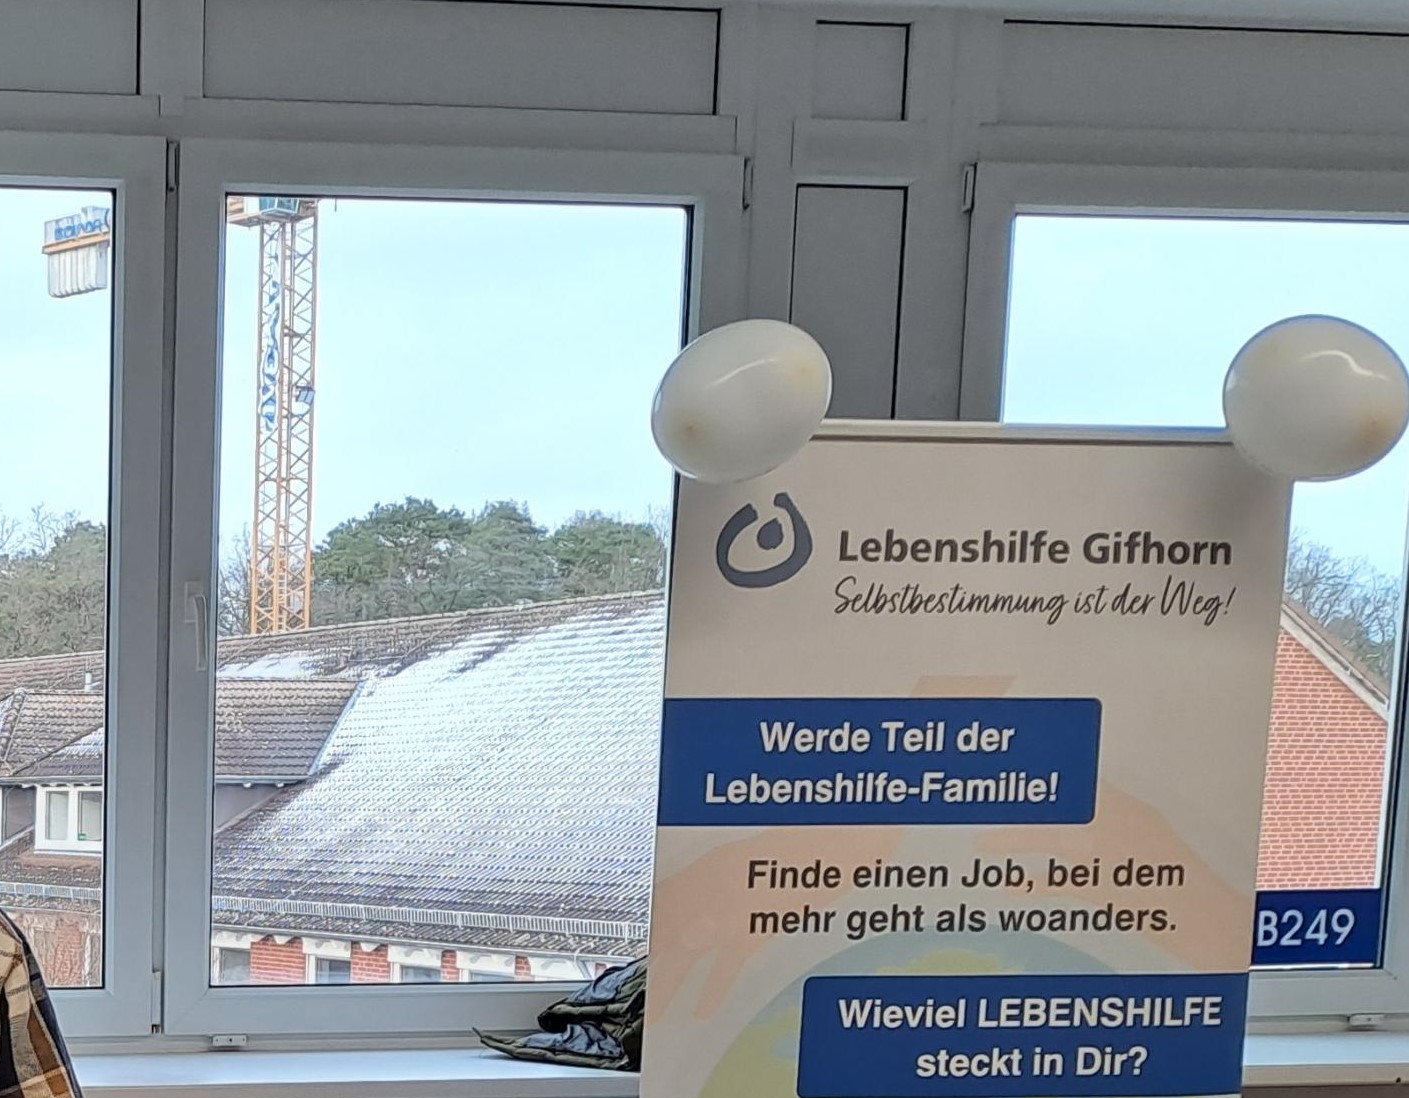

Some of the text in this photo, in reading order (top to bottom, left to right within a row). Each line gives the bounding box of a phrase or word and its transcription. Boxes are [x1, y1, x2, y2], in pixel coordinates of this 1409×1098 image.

[839, 529, 1231, 565] Lebenshilfe Gifhorn
[835, 575, 1236, 626] Selbstbestimmung ist der Weg!
[760, 722, 1015, 752] Werde Teil der
[706, 772, 1058, 803] Lebenshilfe-Familie!
[748, 858, 1184, 892] Finde einen Job, bei dem
[750, 903, 1176, 940] mehr geht als woanders.
[1256, 906, 1356, 947] B249
[839, 997, 1222, 1028] Wieviel LEBENSHILFE
[917, 1046, 1147, 1077] steckt in Dir?
